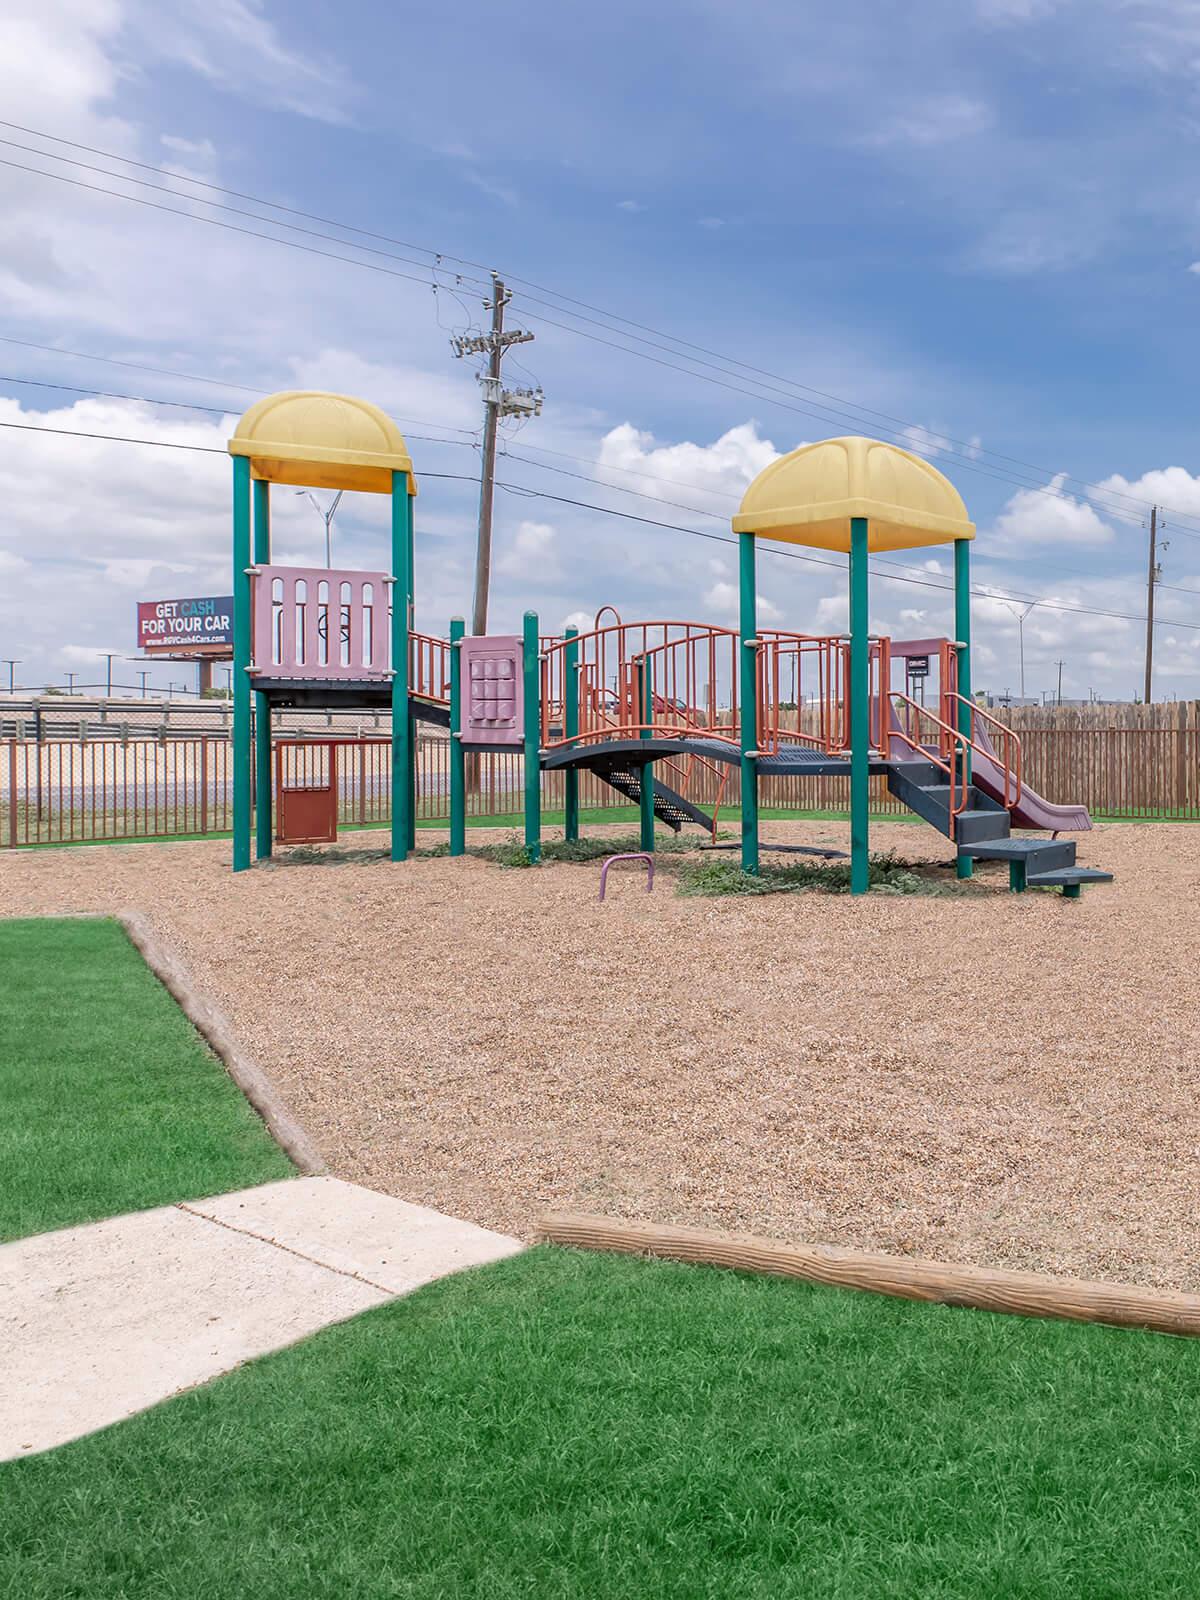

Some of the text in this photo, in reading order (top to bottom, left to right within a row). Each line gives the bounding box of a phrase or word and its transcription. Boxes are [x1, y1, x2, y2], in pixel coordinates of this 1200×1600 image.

[156, 600, 215, 617] GET CASH
[142, 616, 230, 634] FOR YOUR CAR
